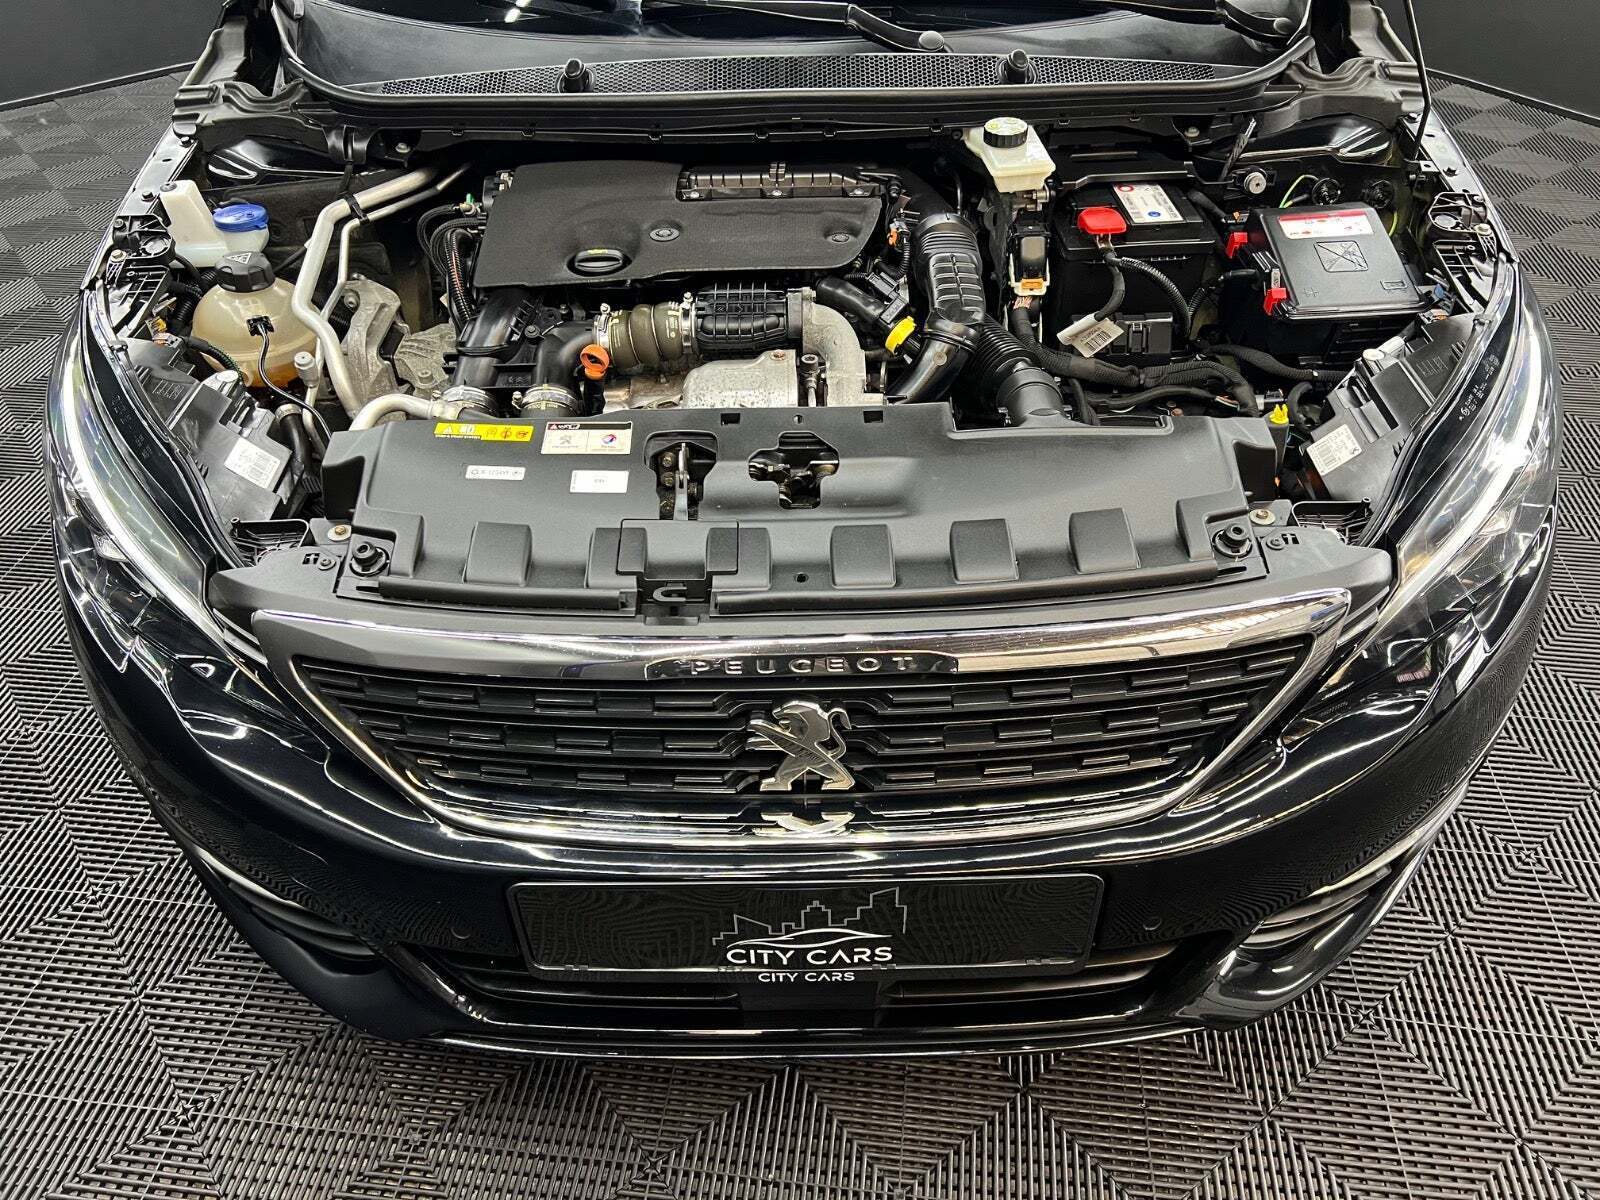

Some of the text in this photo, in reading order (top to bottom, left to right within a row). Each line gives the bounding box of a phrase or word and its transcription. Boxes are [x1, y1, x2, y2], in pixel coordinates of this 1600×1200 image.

[690, 656, 913, 676] PEUGEOT
[726, 946, 893, 966] CITY CARS
[758, 972, 856, 982] CITY CARS
